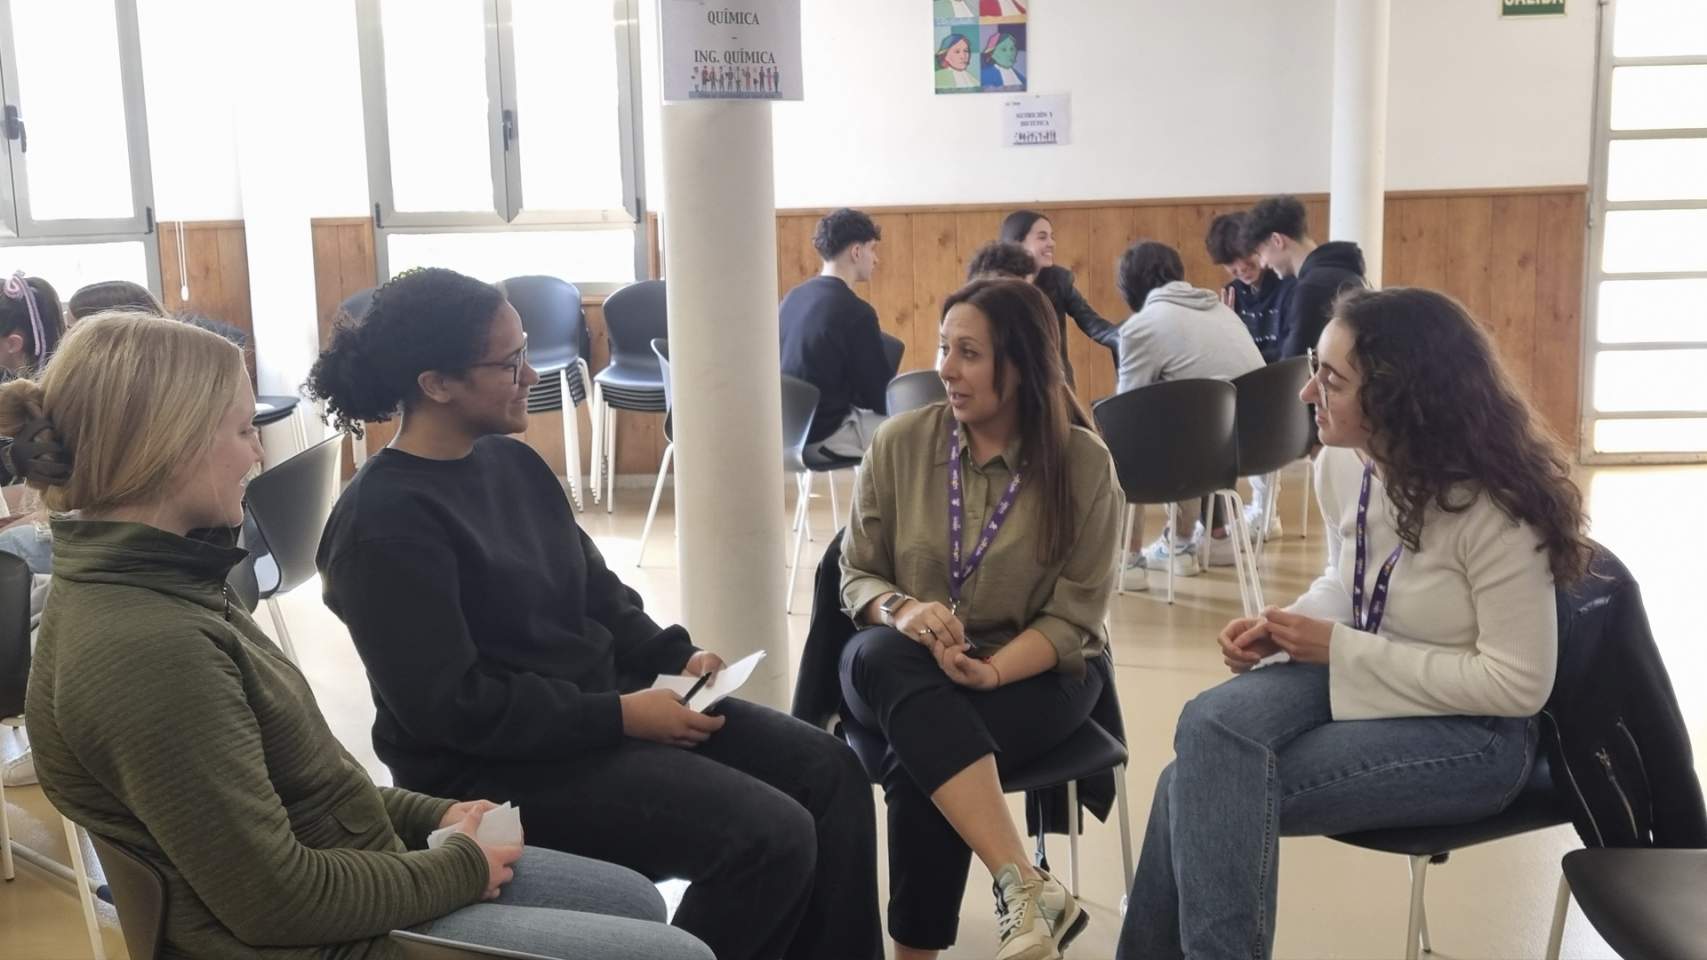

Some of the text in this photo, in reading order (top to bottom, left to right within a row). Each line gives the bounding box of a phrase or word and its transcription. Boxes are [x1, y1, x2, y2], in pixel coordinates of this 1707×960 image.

[707, 8, 760, 25] QUÍMICA
[694, 48, 776, 64] ING. QUÍMICA
